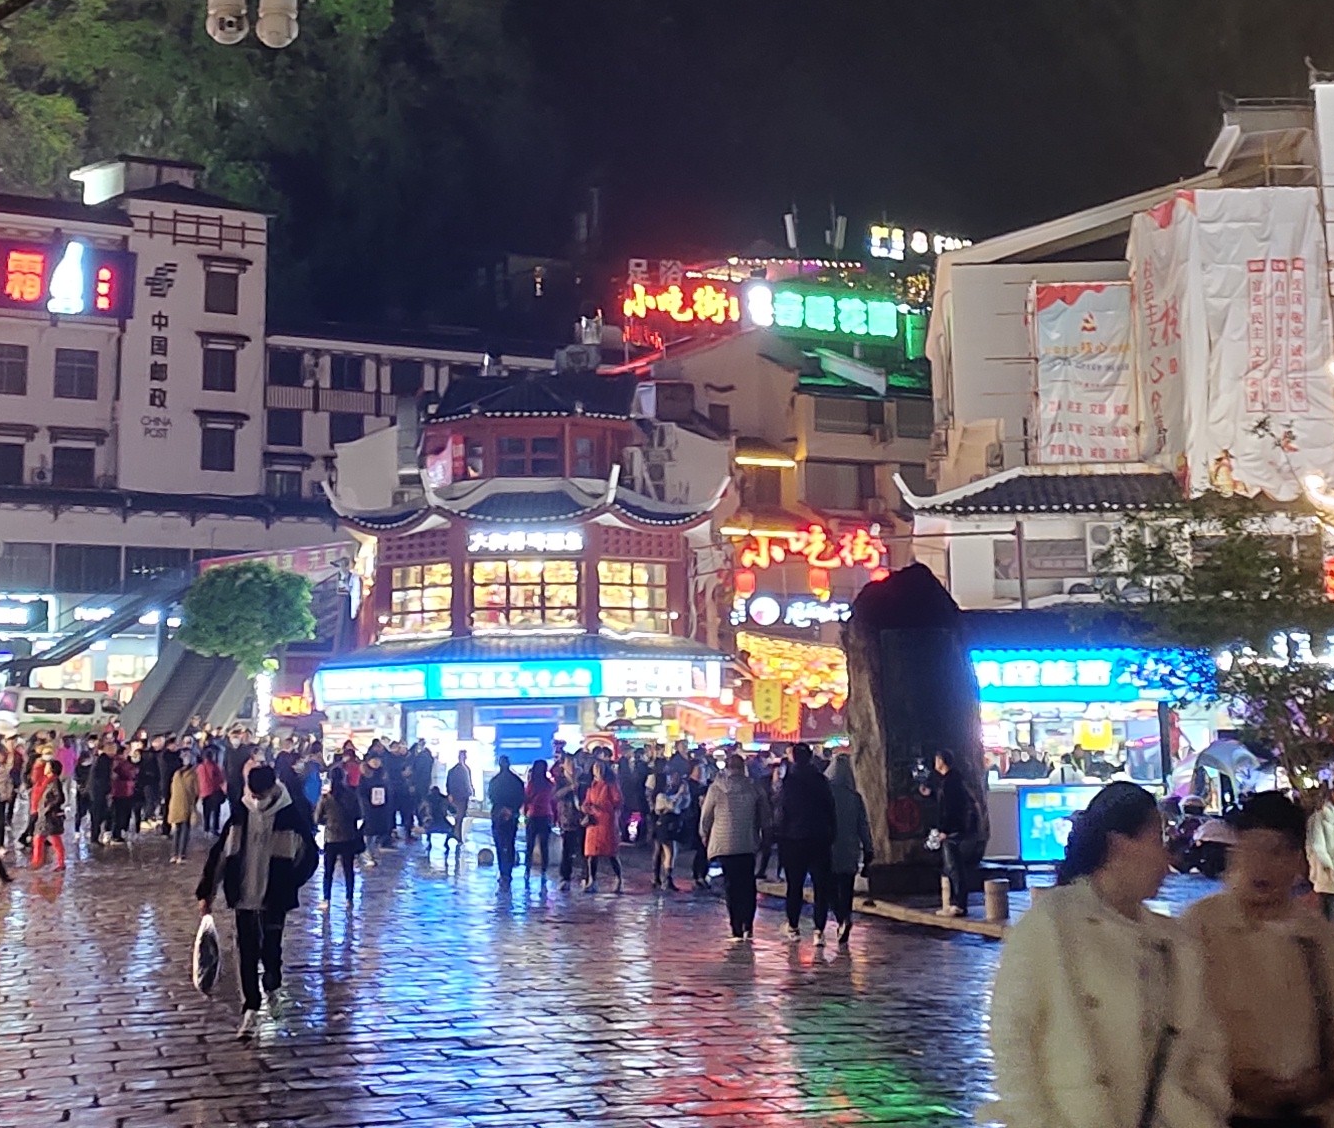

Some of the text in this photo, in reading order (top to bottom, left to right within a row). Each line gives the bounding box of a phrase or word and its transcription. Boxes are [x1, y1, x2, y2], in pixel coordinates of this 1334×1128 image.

[623, 283, 729, 324] 小吃街
[149, 310, 169, 409] 中国邮政
[140, 415, 173, 428] CHINA
[144, 427, 169, 439] POST
[741, 524, 887, 569] 小吃街
